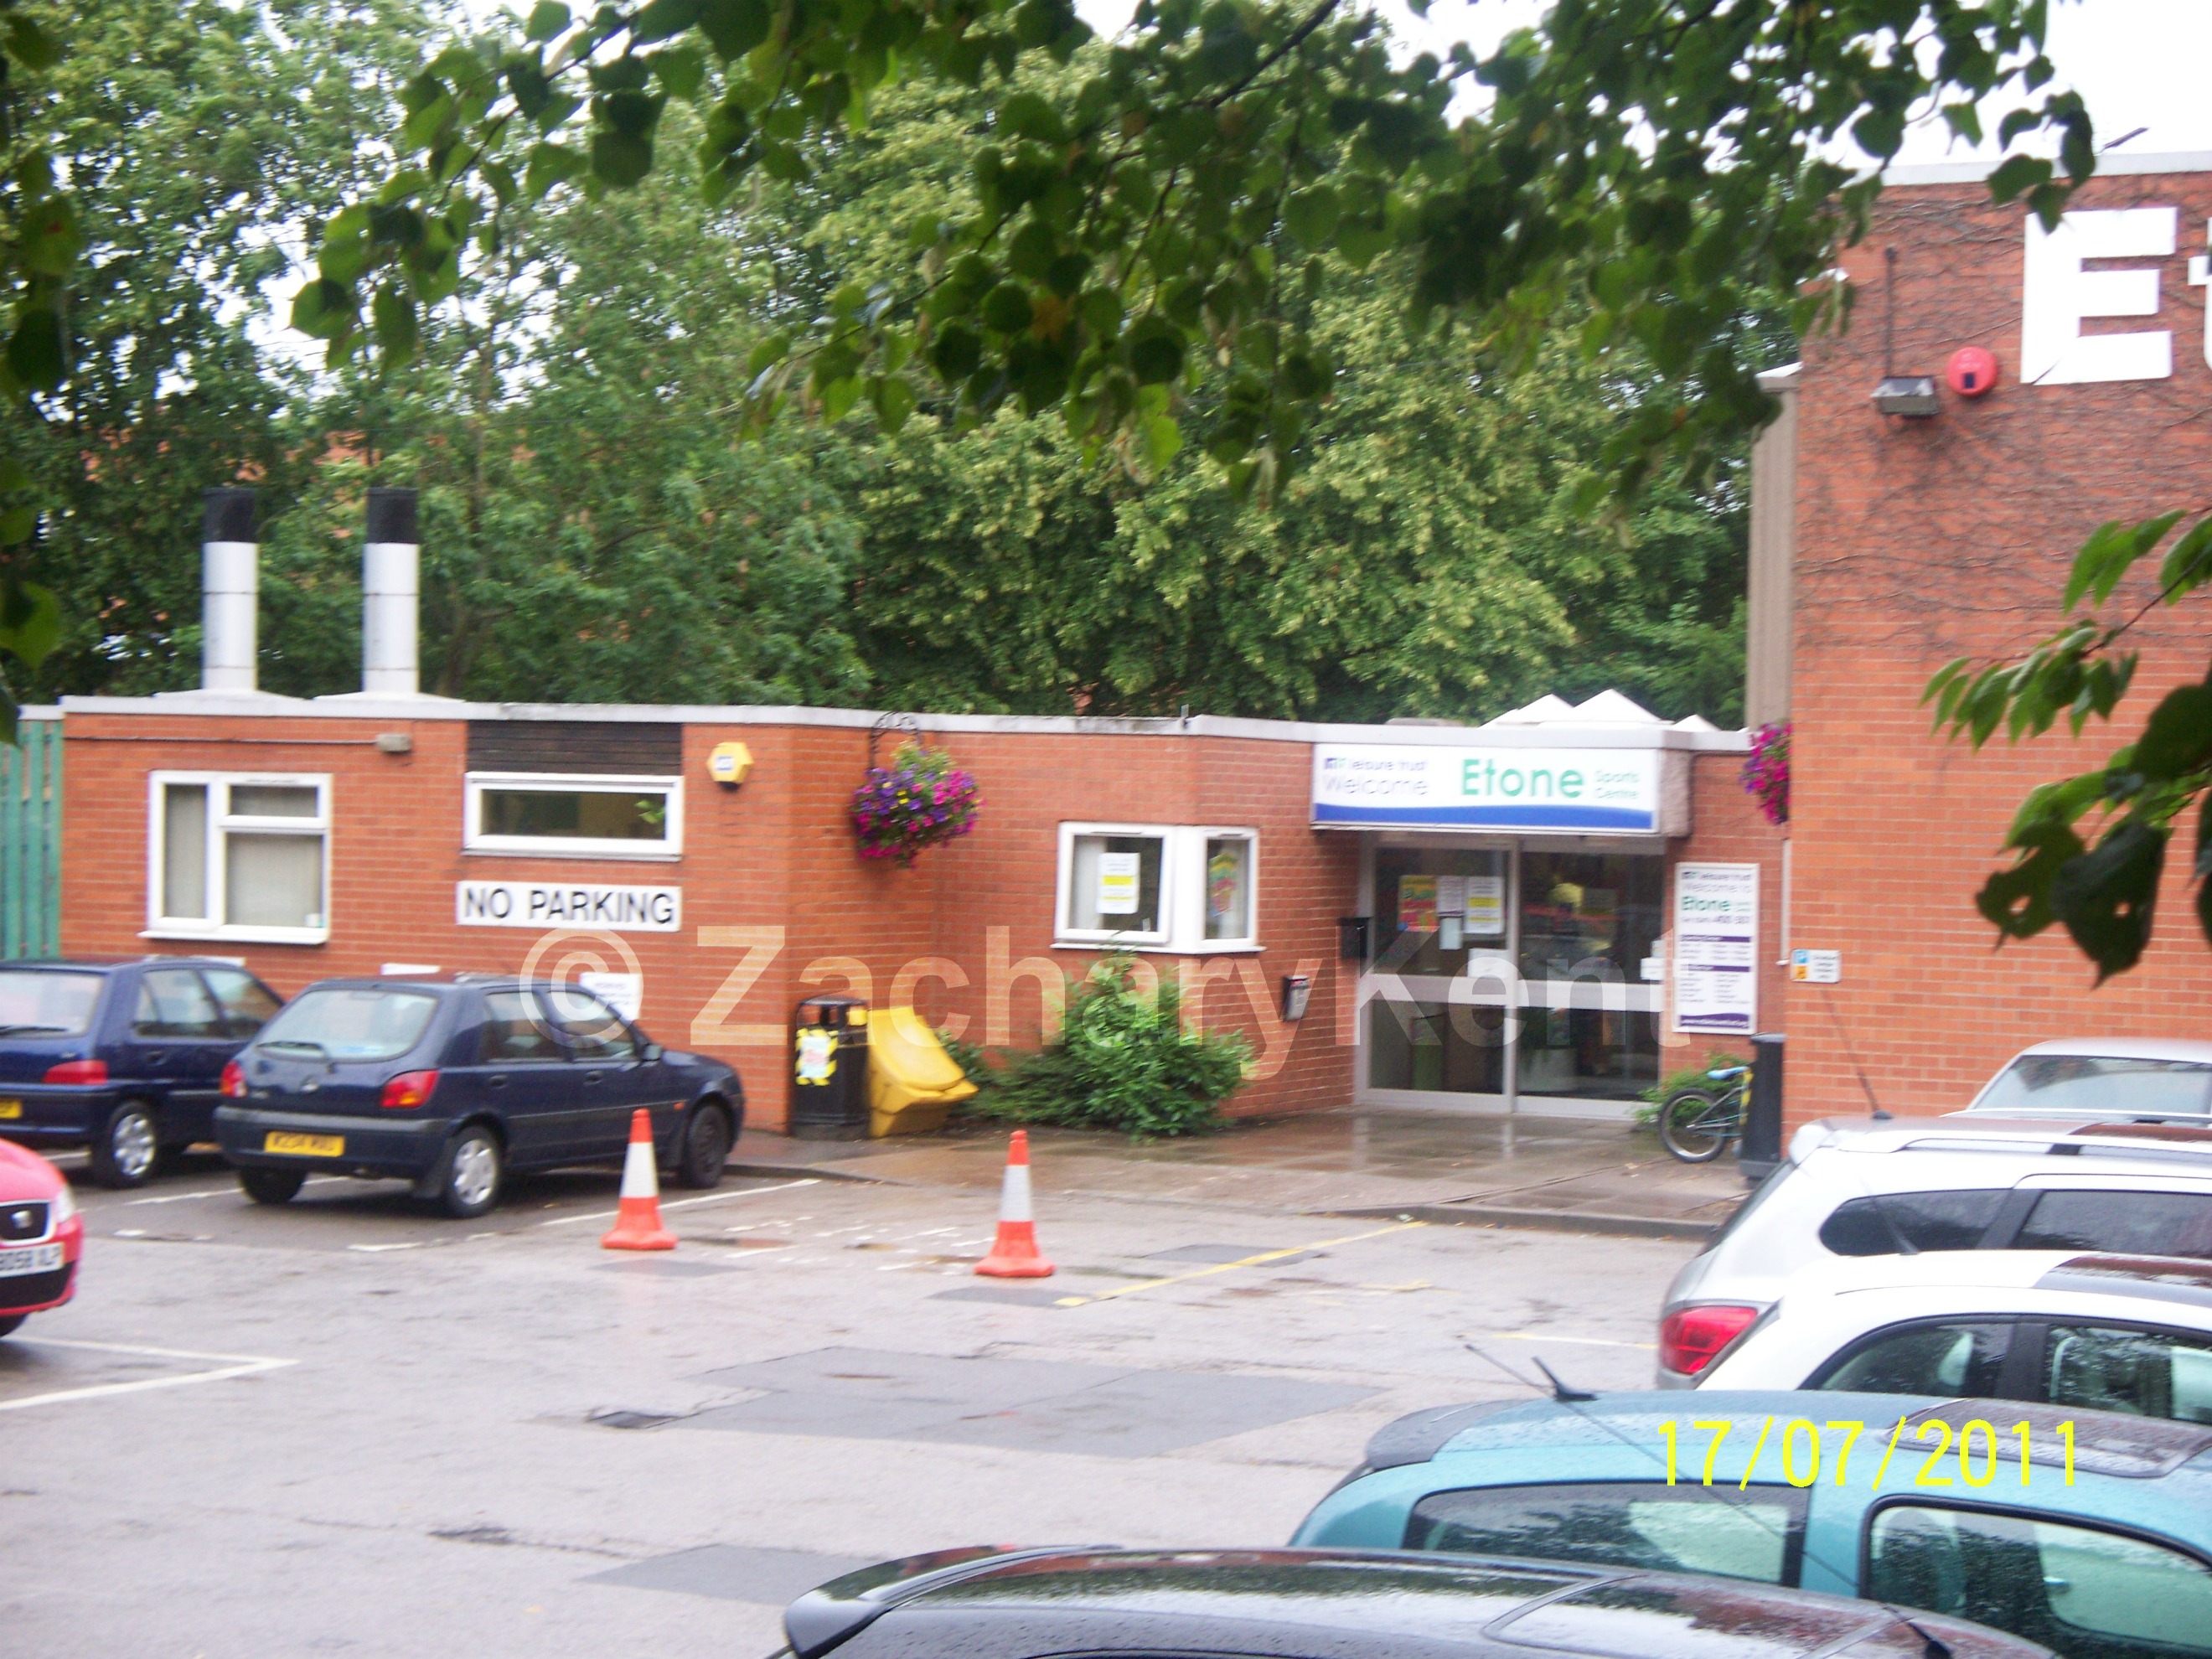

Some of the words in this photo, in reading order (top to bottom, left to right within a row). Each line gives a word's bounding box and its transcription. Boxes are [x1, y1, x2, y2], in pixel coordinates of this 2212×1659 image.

[1323, 773, 1429, 795] Welcome
[1461, 757, 1585, 798] Etone
[465, 886, 512, 919] NO
[528, 889, 674, 924] PARKING
